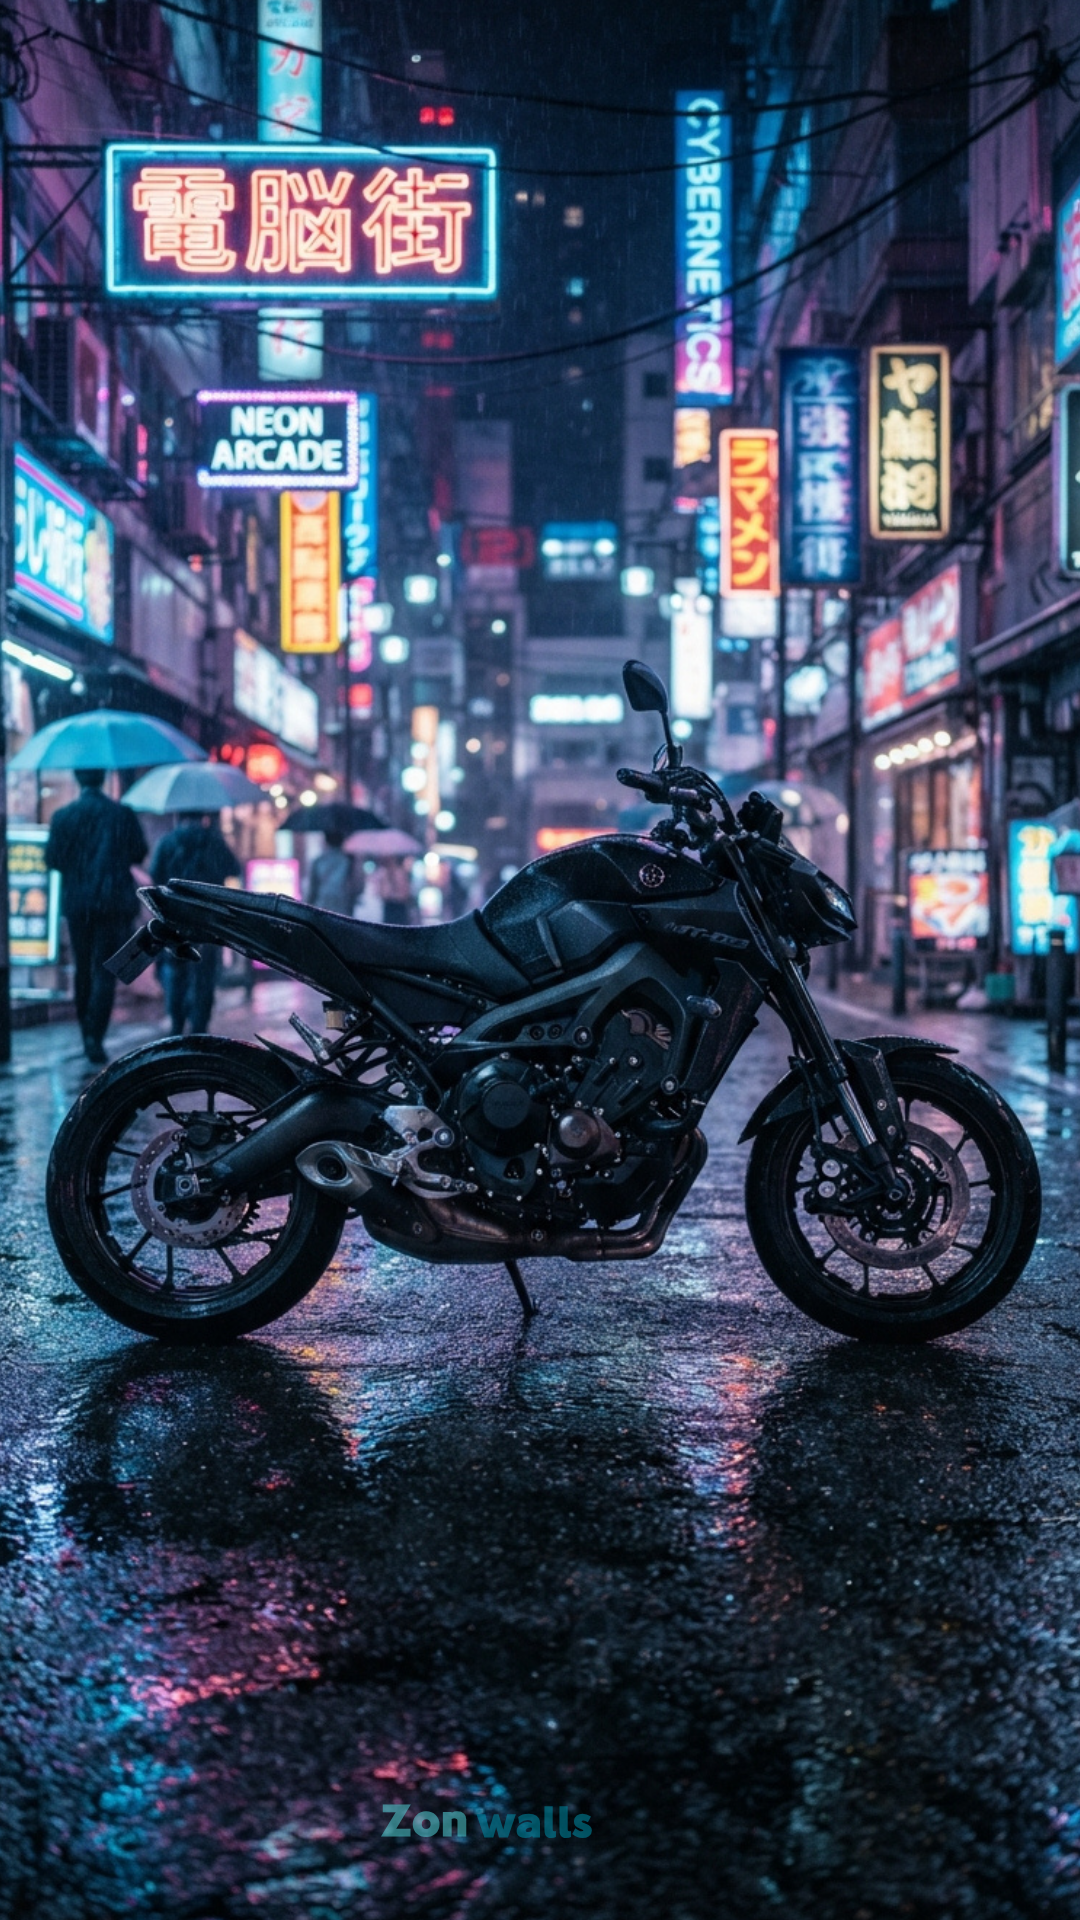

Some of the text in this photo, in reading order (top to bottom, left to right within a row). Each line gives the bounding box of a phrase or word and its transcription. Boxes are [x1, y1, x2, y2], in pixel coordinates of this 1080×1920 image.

[132, 166, 472, 274] 電脳街
[685, 97, 722, 393] CYBERNETICS
[210, 438, 344, 471] ARCADE
[230, 405, 324, 437] NEON
